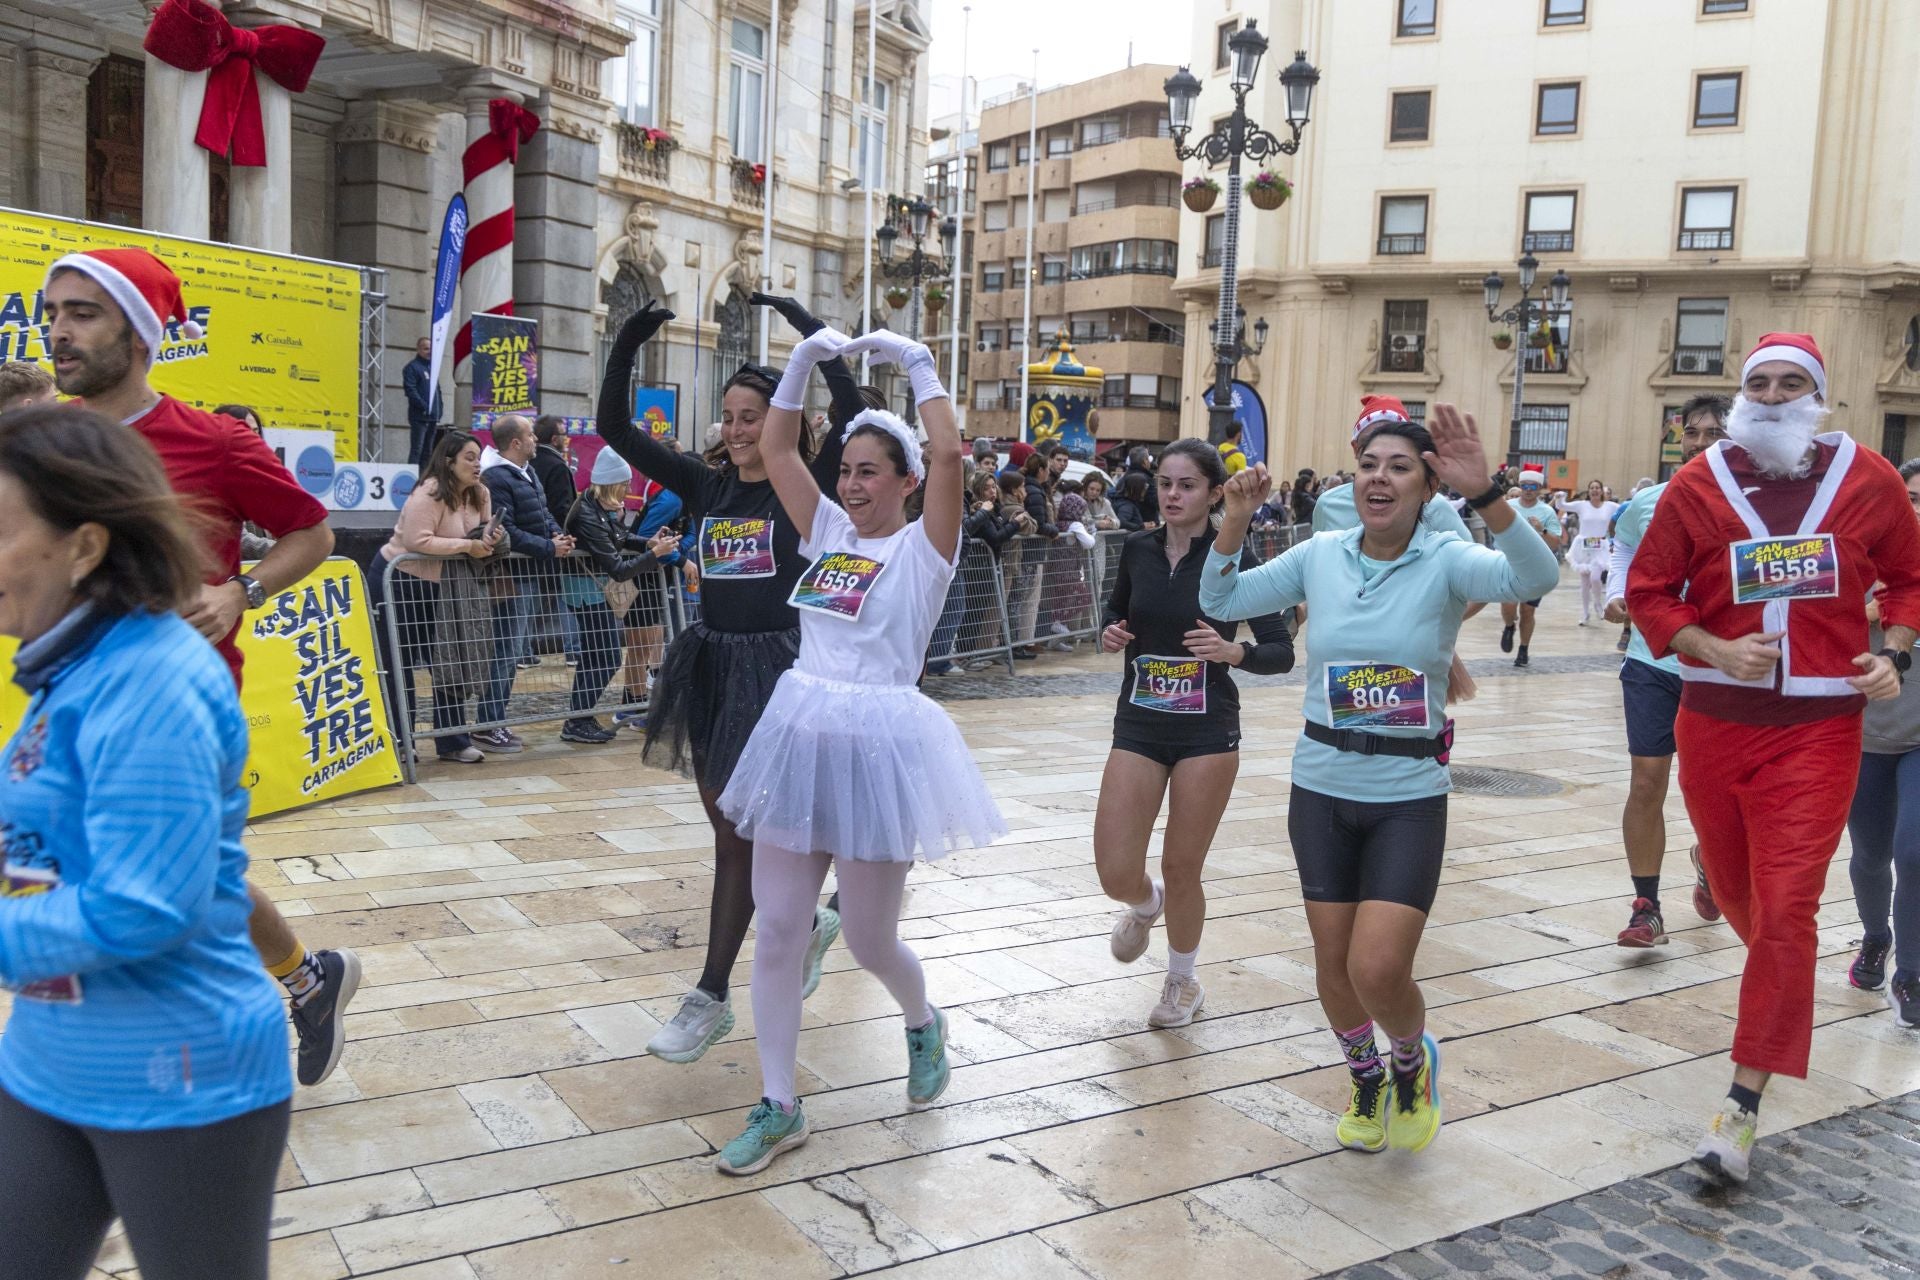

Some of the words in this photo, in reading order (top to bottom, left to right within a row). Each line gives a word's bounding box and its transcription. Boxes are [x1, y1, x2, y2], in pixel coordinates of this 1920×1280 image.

[488, 336, 529, 355] SAN
[250, 366, 276, 374] VERDAD
[494, 353, 523, 372] SIL
[491, 368, 528, 388] VES
[491, 385, 529, 405] TRE
[370, 476, 385, 500] 3
[712, 520, 765, 540] SILVESTRE
[713, 520, 731, 532] SAN
[710, 538, 758, 558] 1723
[1755, 542, 1782, 556] SAN
[1756, 540, 1823, 564] SILVESTRE
[814, 568, 860, 595] 1559
[1754, 558, 1818, 584] 1558
[274, 575, 353, 637] SAN
[293, 621, 351, 677] SIL
[1149, 661, 1168, 669] SAN
[1149, 662, 1199, 676] SILVESTRE
[1348, 667, 1375, 680] SAN
[292, 656, 364, 720] VES
[1146, 674, 1192, 698] 1370
[1346, 668, 1414, 690] SILVESTRE
[1352, 686, 1400, 710] 806
[300, 698, 374, 764] TRE
[302, 736, 384, 792] CARTAGENA
